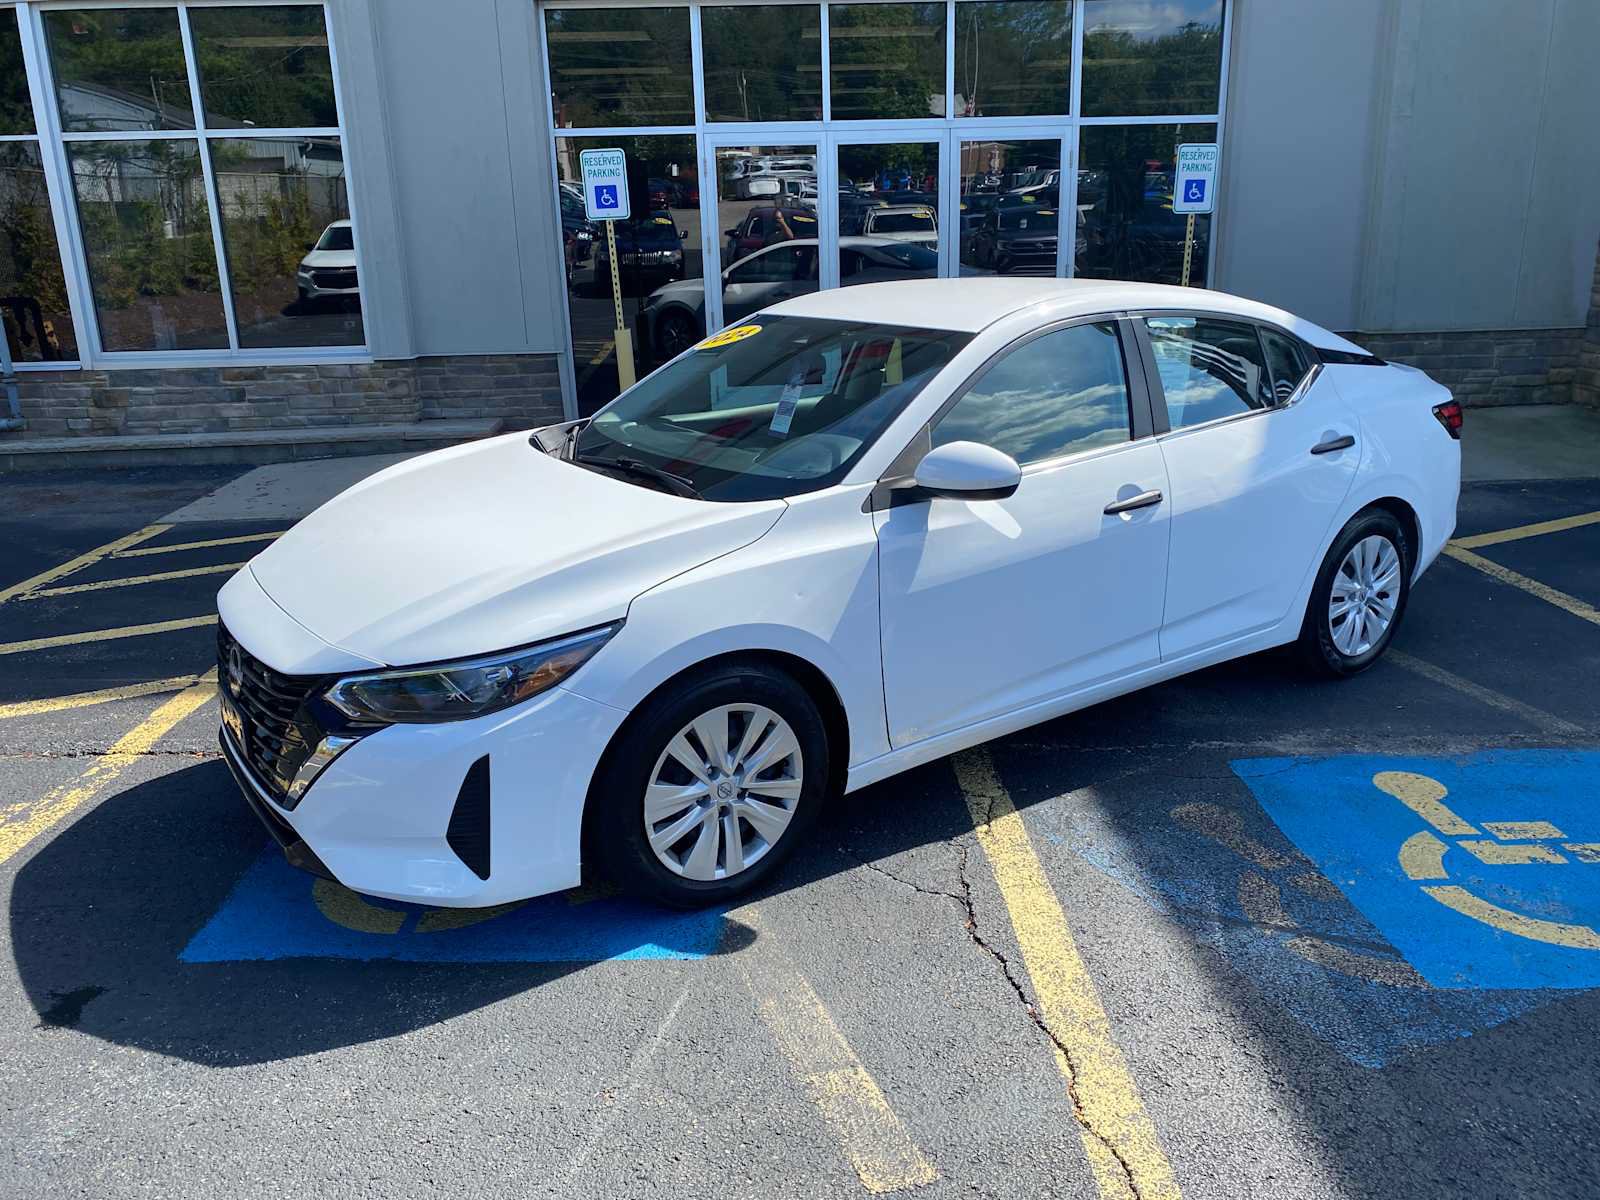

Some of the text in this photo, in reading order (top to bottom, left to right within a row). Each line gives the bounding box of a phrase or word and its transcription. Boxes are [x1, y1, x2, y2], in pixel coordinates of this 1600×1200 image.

[1180, 151, 1216, 161] RESERVED
[584, 156, 622, 167] RESERVED
[1182, 163, 1212, 172] PARKING
[587, 168, 620, 178] PARKING
